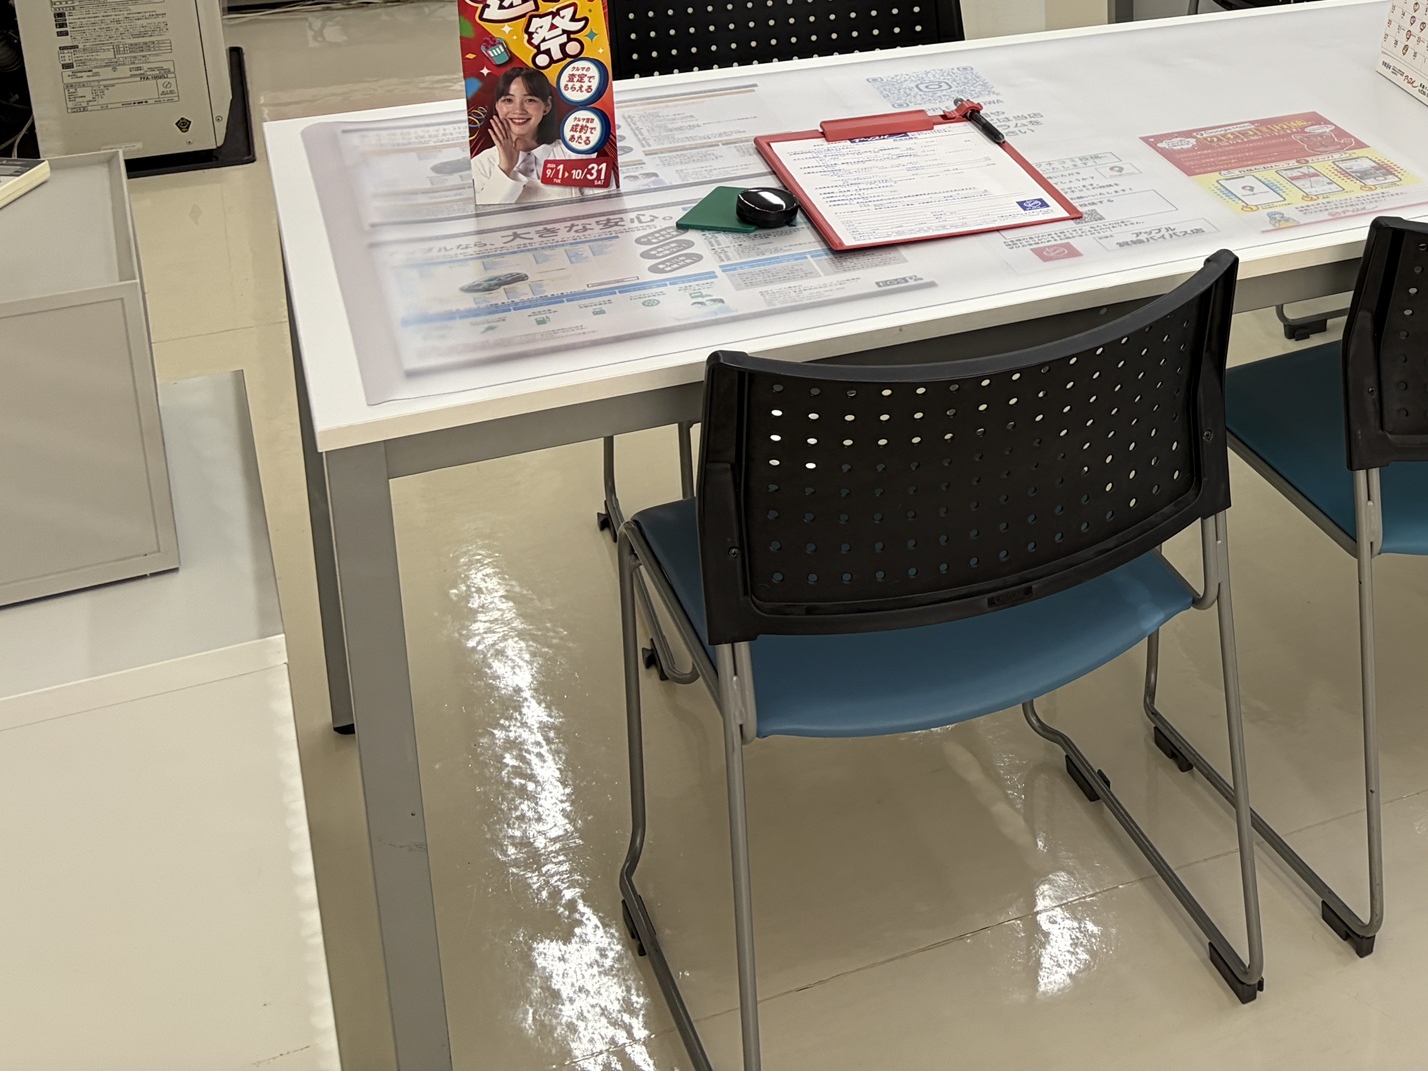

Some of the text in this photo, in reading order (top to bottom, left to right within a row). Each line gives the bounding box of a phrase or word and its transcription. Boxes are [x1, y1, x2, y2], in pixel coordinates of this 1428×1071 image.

[566, 71, 596, 84] 査定で
[563, 82, 594, 94] もらえる
[569, 122, 597, 134] 成約で
[568, 133, 591, 146] あたる
[546, 162, 608, 180] 9/1 10/31
[500, 212, 673, 245] 大きな安心。
